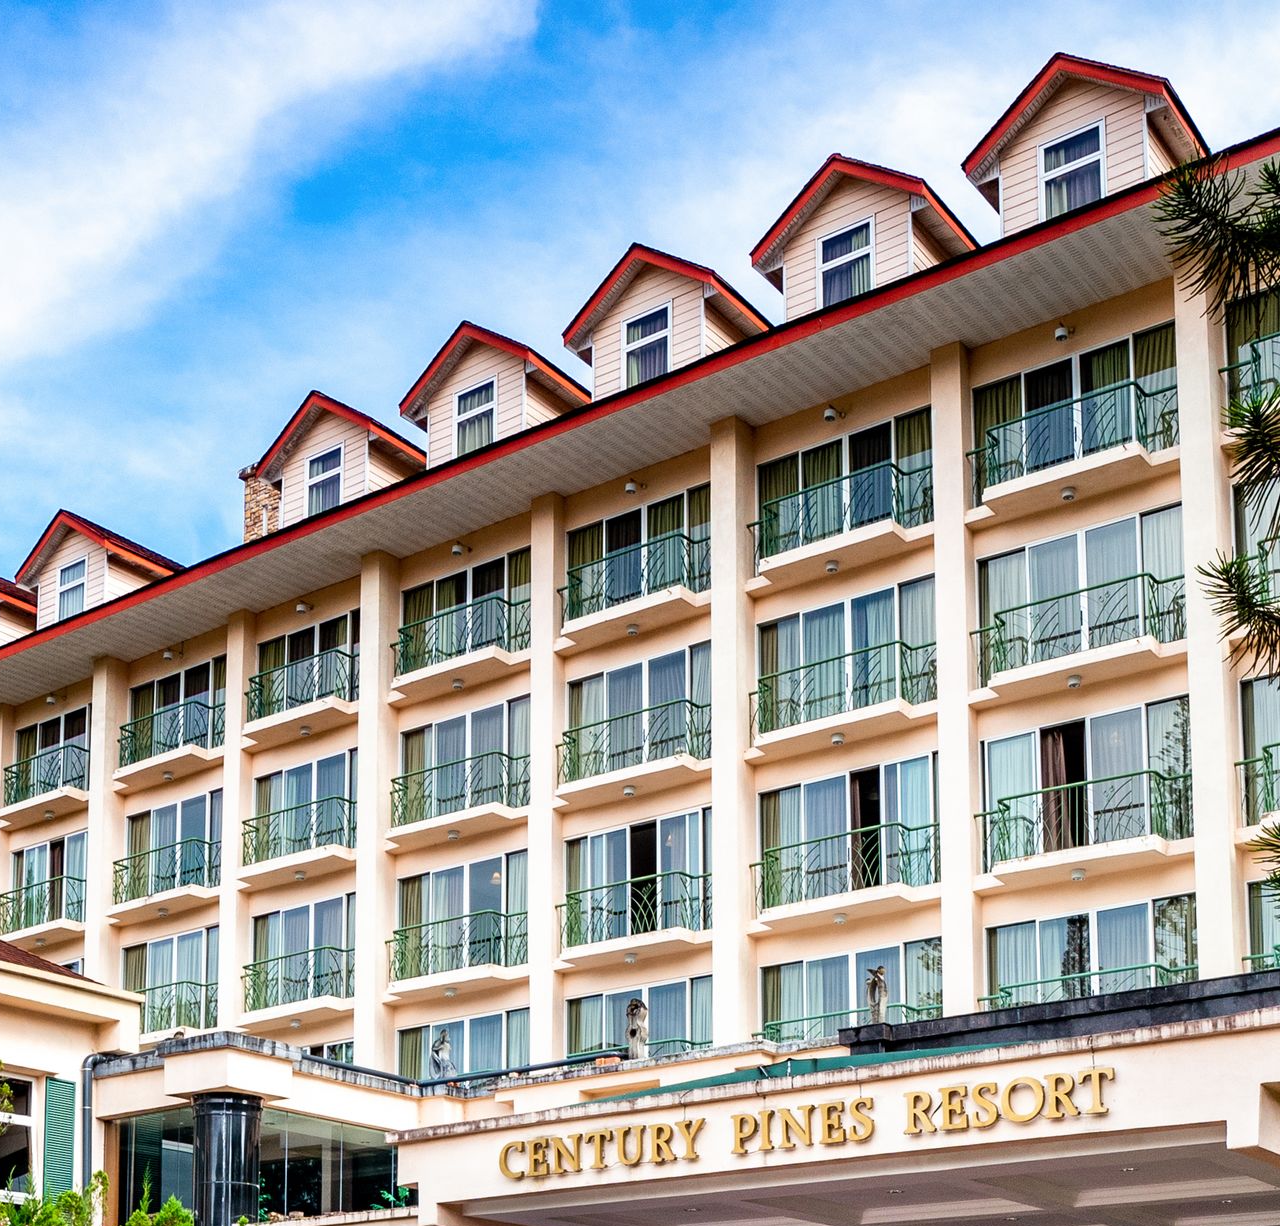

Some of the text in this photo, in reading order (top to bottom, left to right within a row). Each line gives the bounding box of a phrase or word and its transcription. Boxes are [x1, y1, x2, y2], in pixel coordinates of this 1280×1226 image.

[498, 1066, 1116, 1181] CENTURY PINES RESORT
